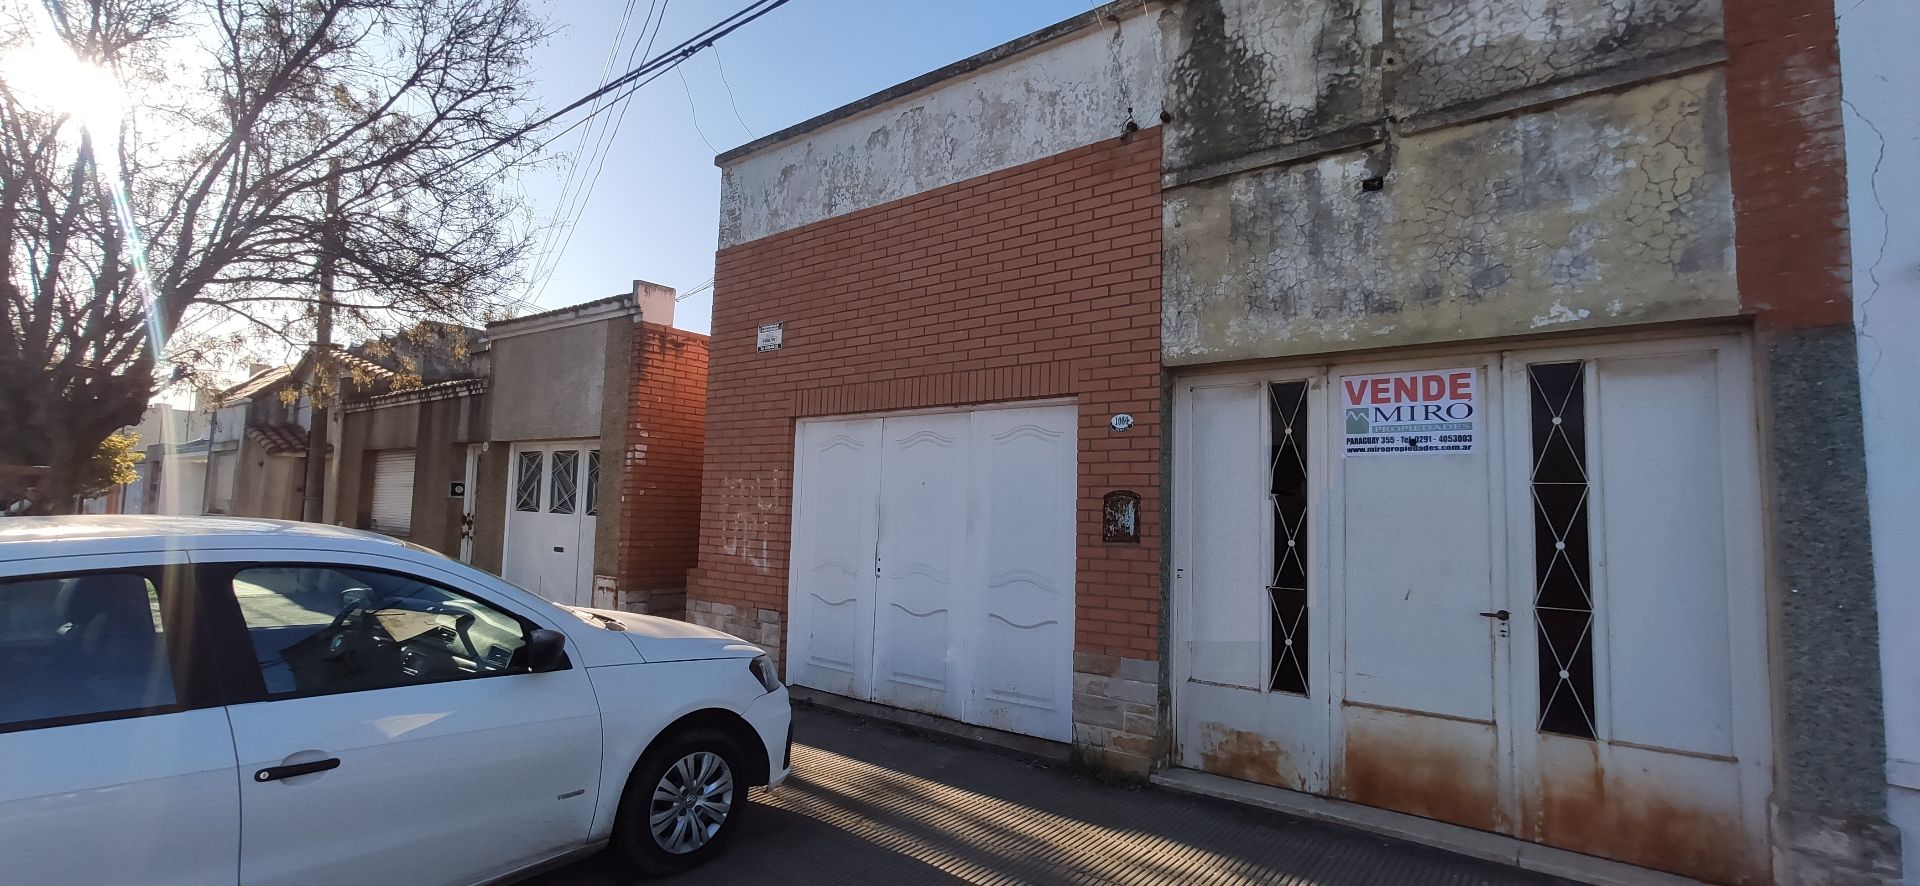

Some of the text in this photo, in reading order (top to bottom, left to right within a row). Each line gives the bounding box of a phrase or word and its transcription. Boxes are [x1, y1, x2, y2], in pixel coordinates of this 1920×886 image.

[1344, 372, 1472, 406] VENDE
[1375, 423, 1471, 433] PROPIEDADES
[1346, 437, 1379, 445] PARAGUAY
[1381, 436, 1395, 444] 355
[1438, 434, 1473, 443] 4053003
[1346, 444, 1472, 453] www.miropropiedades.com.ar
